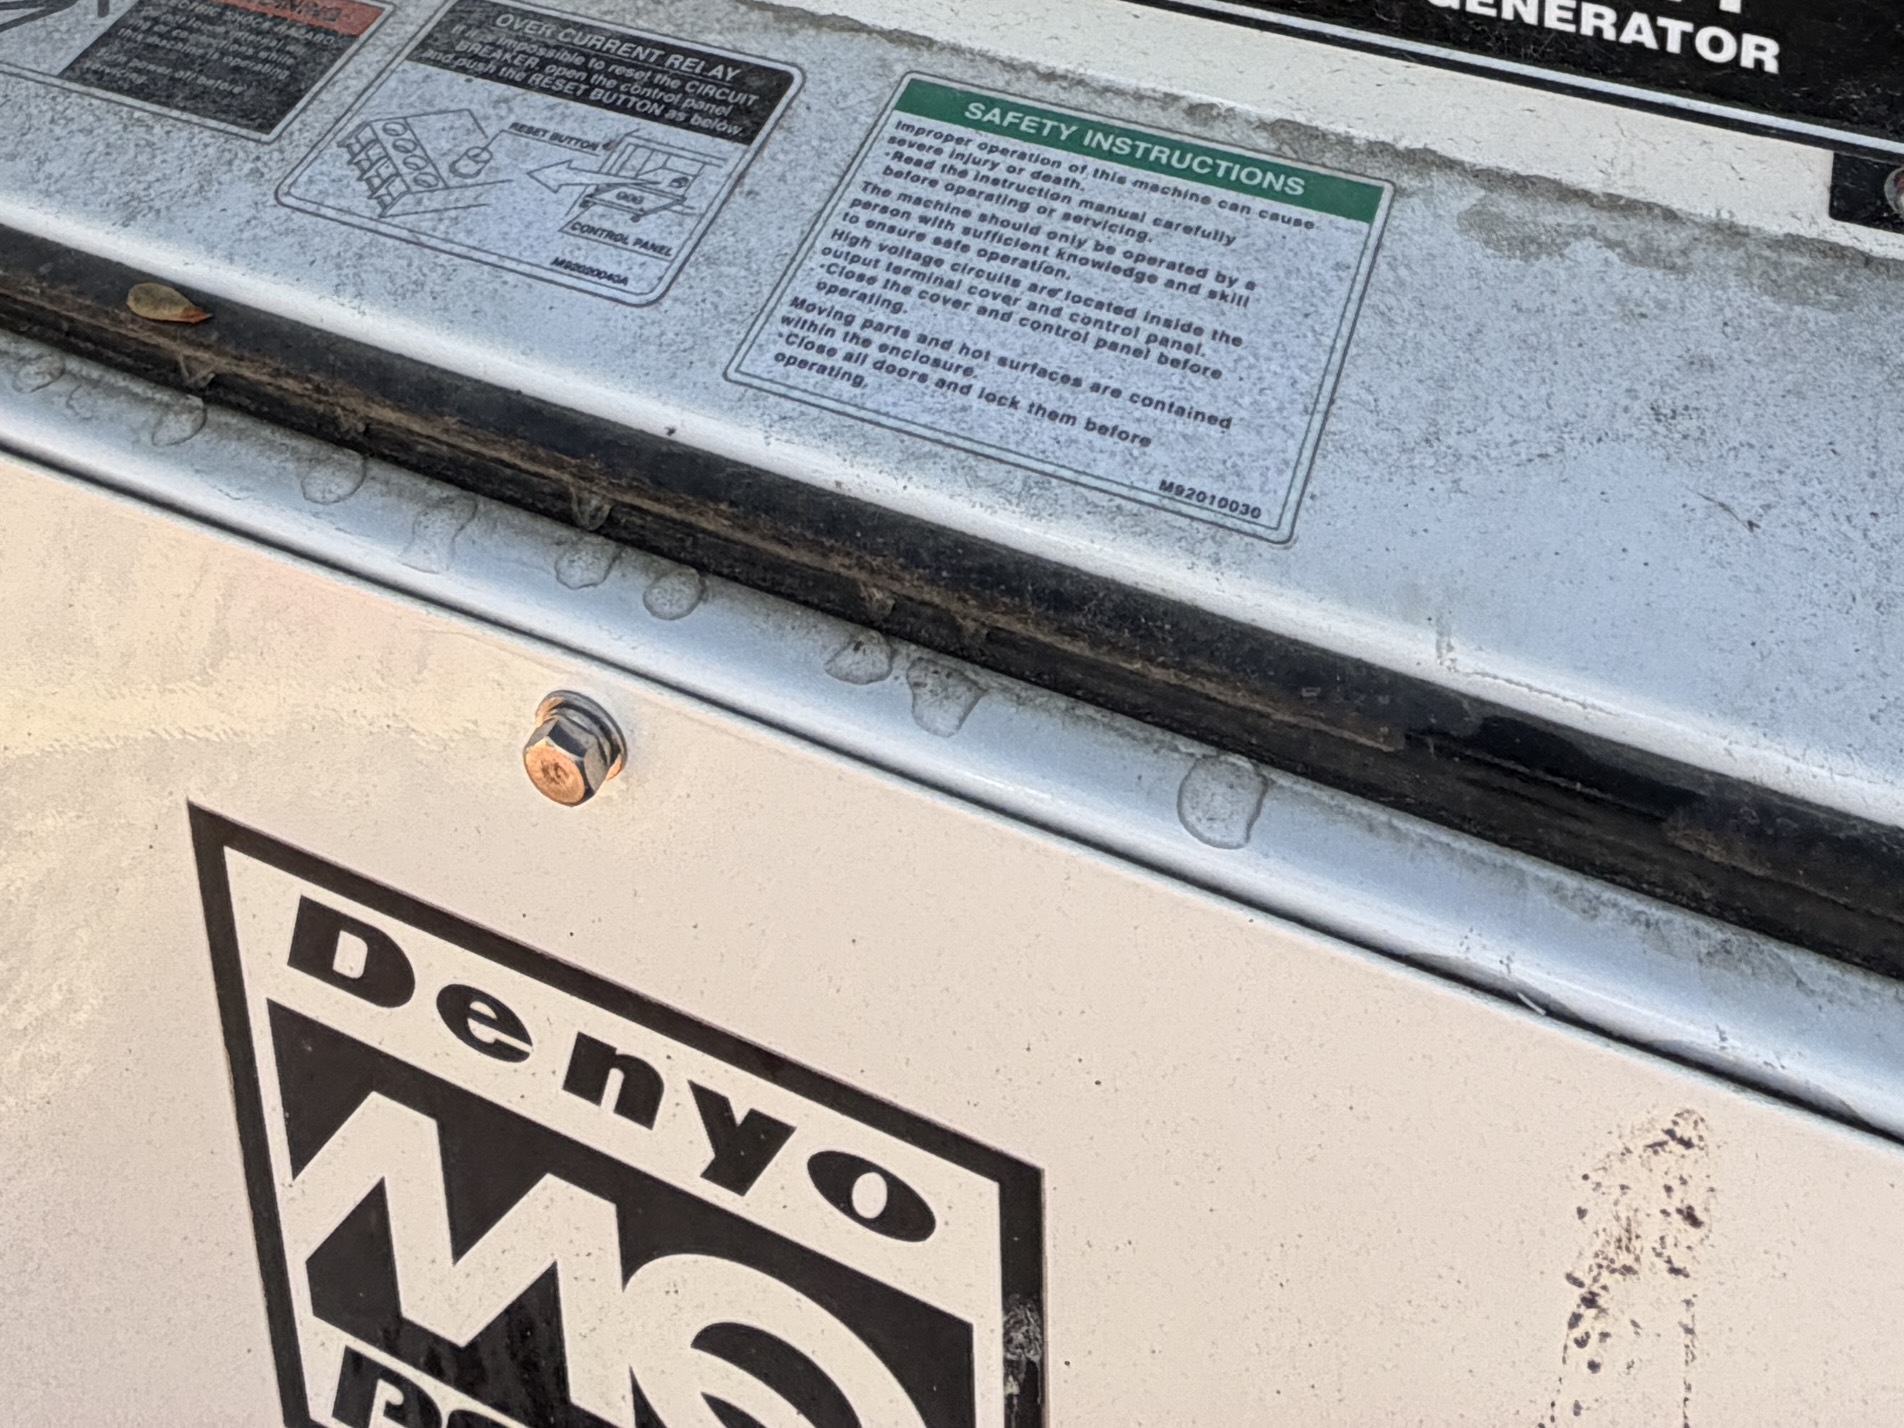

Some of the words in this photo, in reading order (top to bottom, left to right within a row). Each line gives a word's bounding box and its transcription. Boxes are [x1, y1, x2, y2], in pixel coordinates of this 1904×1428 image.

[495, 13, 553, 36] OVER
[558, 26, 663, 68] CURRENT
[665, 50, 742, 82] RELAY
[895, 120, 973, 148] Improper
[977, 141, 1062, 171] operation
[1069, 162, 1088, 175] of
[1093, 167, 1127, 186] this
[1132, 178, 1212, 206] machine
[1218, 196, 1253, 216] can
[964, 102, 1076, 143] SAFETY
[1083, 130, 1306, 196] INSTRUCTIONS
[571, 222, 628, 245] CONTROL
[632, 238, 672, 256] PANEL
[287, 895, 936, 1242] Denyo
